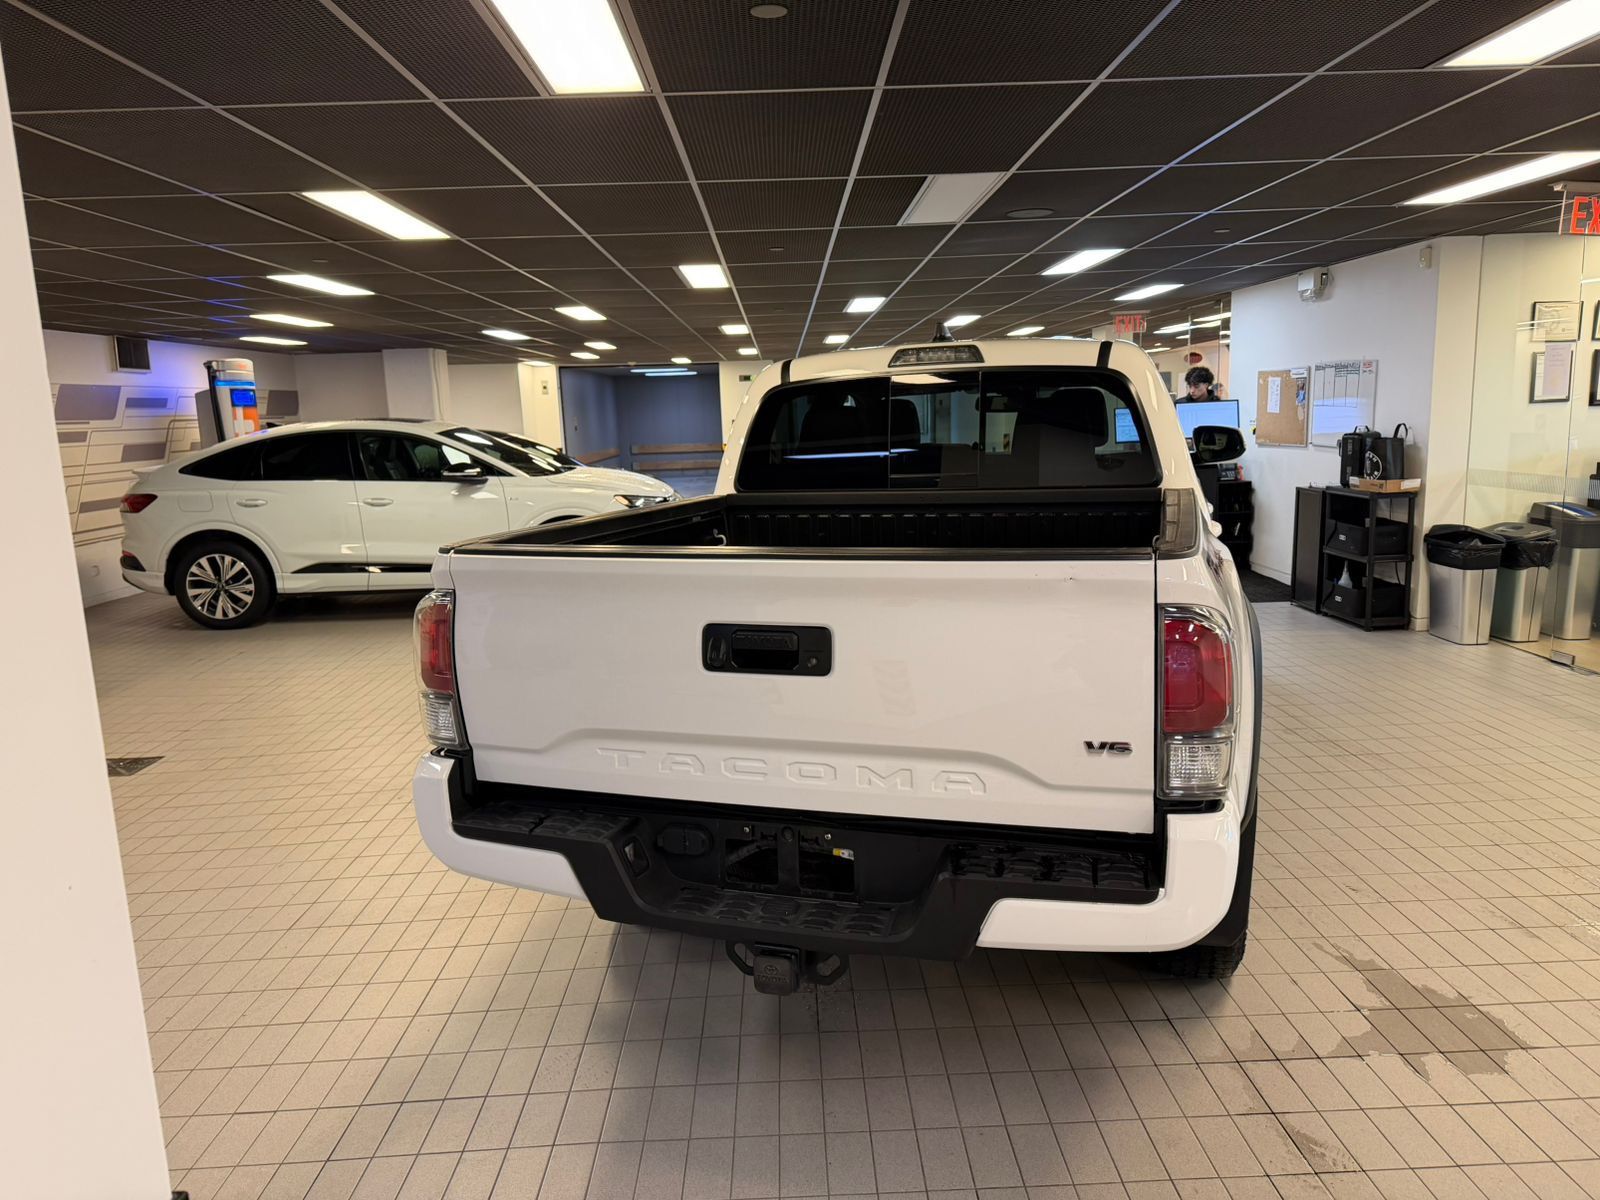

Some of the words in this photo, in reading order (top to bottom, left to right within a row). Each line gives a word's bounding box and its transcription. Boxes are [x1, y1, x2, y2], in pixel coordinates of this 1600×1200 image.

[1115, 315, 1143, 335] EXIT
[1083, 740, 1133, 756] V6
[596, 747, 988, 796] TACOMA
[757, 975, 788, 984] TOYOTA
